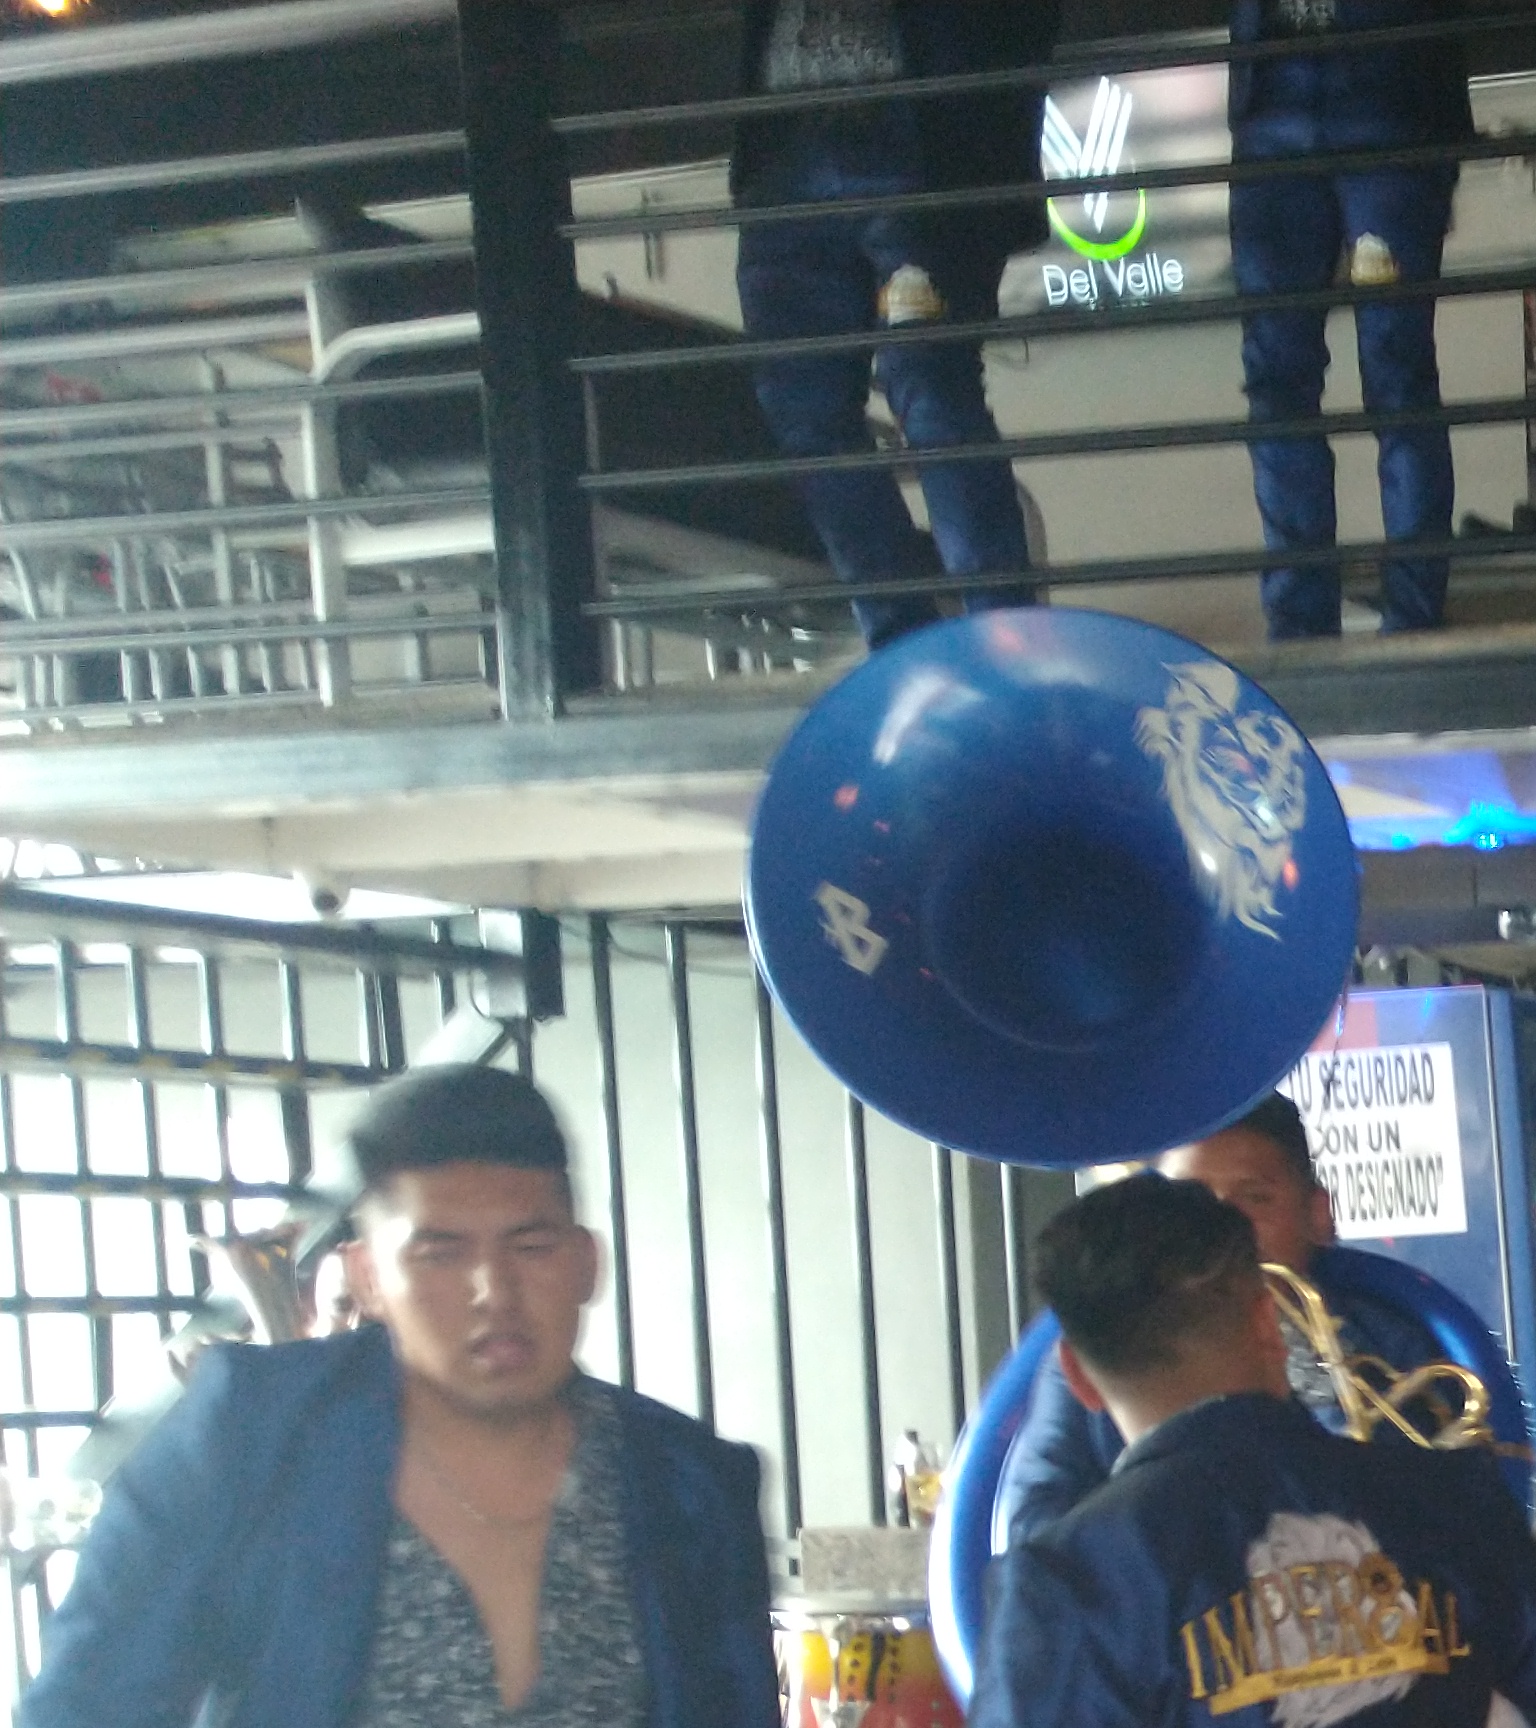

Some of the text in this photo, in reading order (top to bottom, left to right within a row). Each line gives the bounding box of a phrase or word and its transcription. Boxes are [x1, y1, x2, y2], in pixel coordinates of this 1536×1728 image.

[1043, 252, 1184, 305] Del Valle
[1319, 1050, 1435, 1111] SEGURIDAD
[1368, 1119, 1401, 1154] UN
